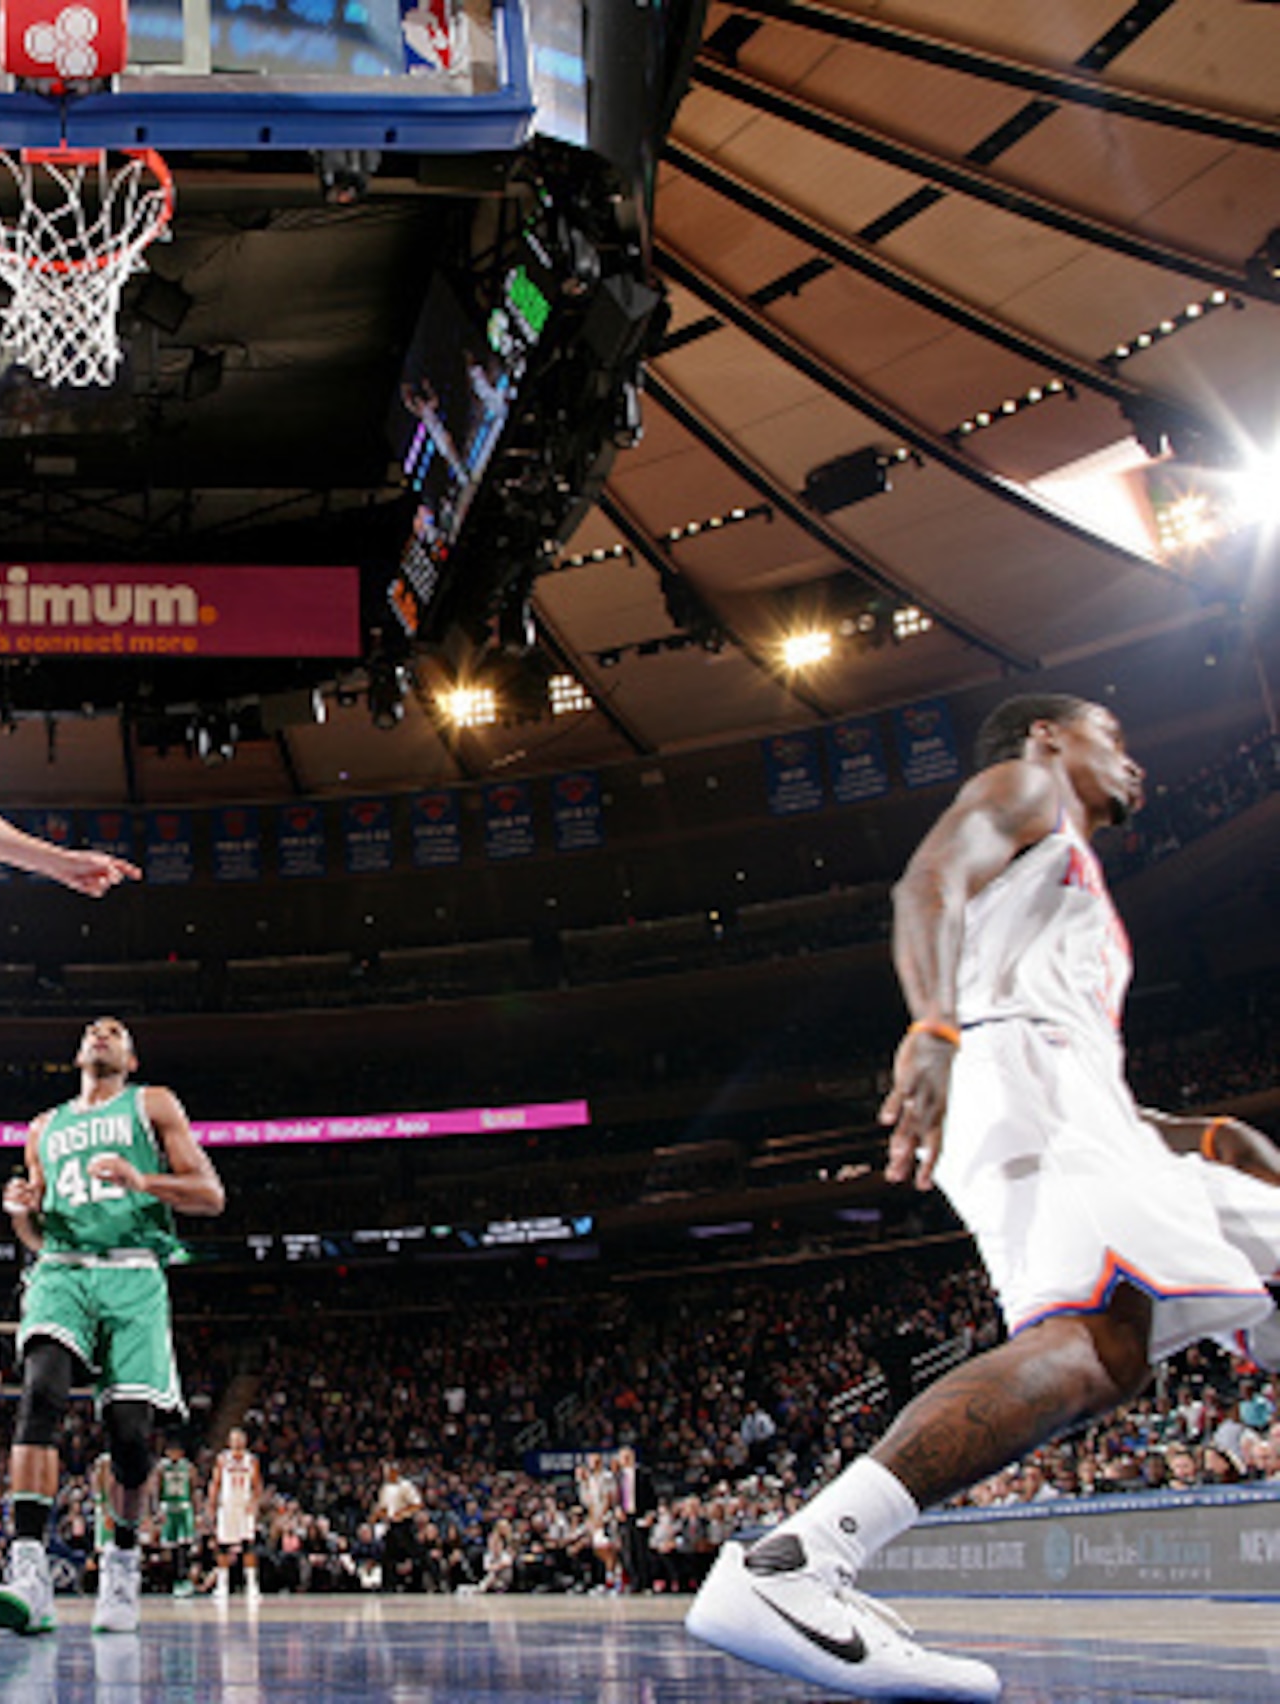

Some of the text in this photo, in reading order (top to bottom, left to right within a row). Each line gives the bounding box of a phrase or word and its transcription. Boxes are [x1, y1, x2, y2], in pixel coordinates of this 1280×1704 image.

[16, 632, 122, 653] connect
[129, 635, 197, 653] more
[47, 1115, 133, 1162] BOSTON
[56, 1152, 126, 1207] 42
